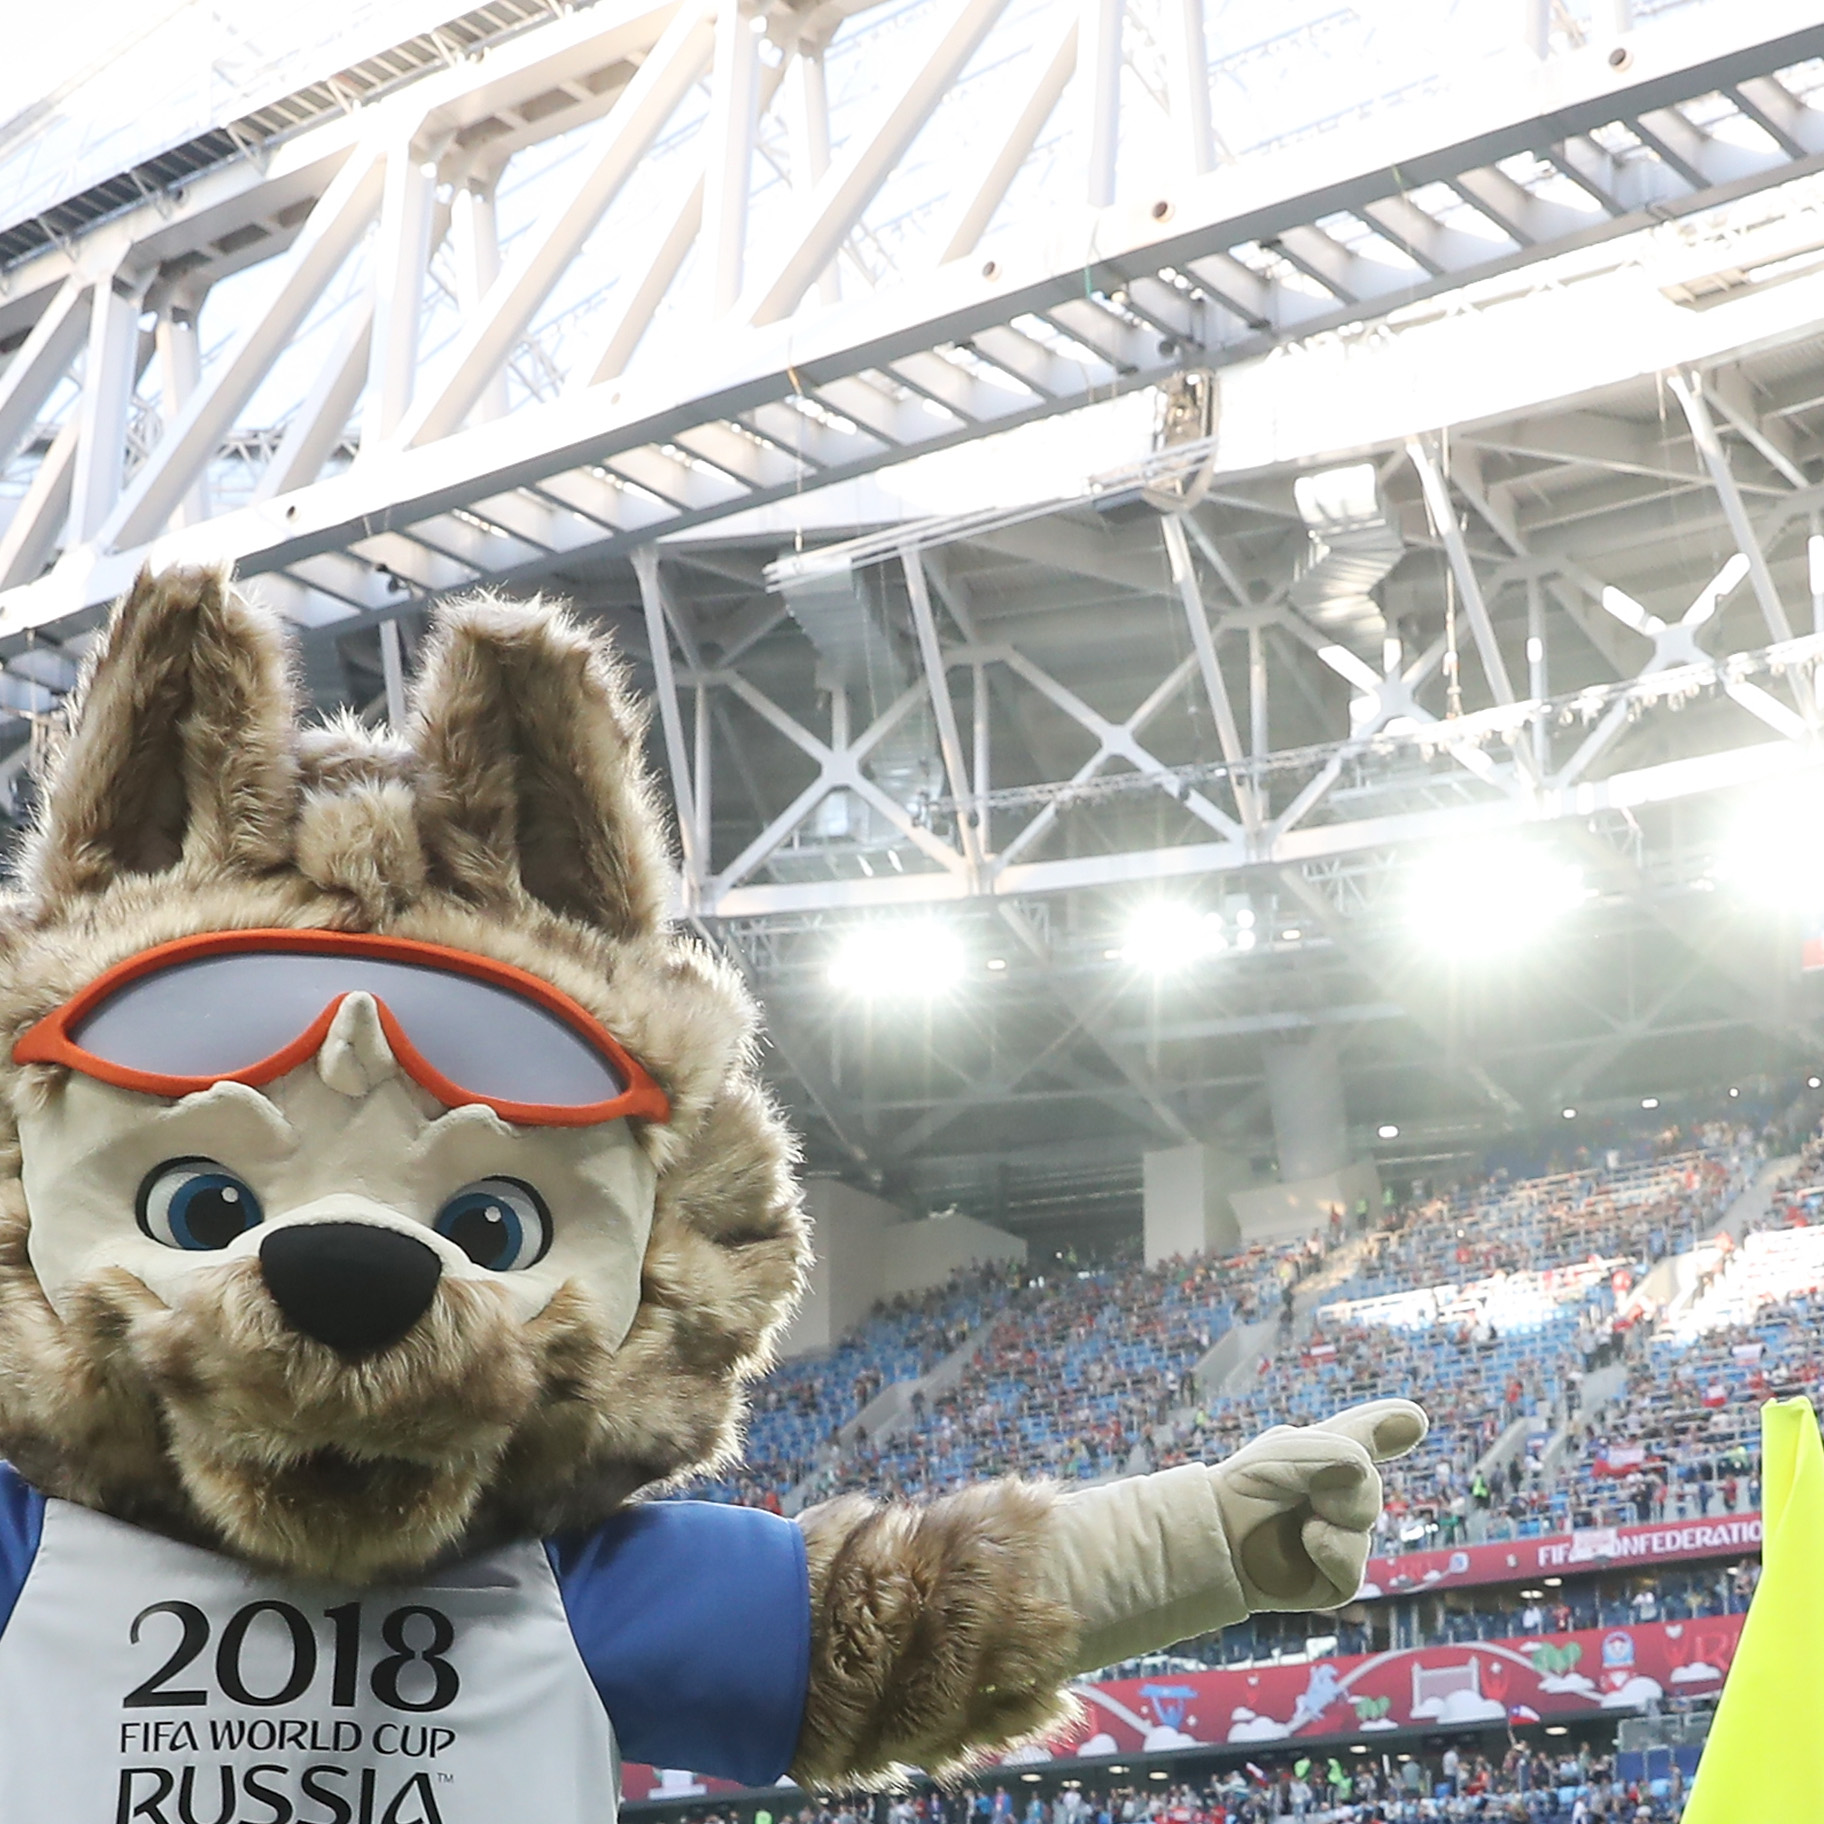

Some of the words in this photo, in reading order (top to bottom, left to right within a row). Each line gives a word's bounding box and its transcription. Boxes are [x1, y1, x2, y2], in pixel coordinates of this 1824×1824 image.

[122, 1600, 460, 1712] 2018
[121, 1720, 199, 1753] FIFA
[210, 1720, 362, 1752] WORLD
[373, 1724, 456, 1758] CUP
